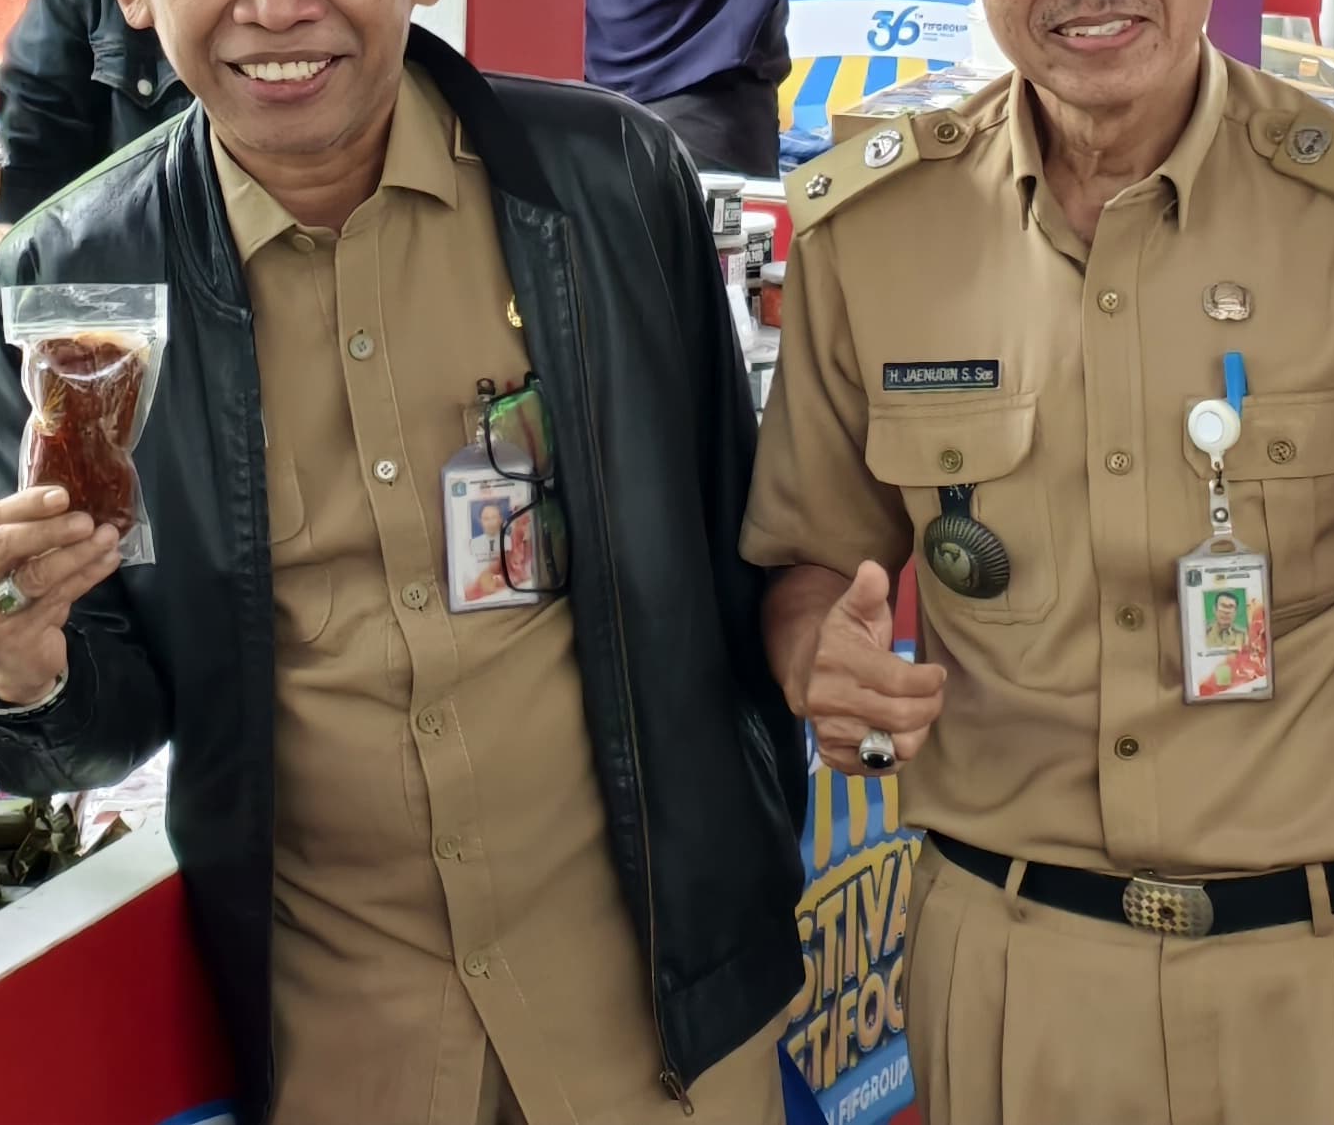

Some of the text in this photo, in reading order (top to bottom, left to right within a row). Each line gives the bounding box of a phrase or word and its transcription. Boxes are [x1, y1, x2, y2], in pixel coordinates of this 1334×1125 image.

[867, 5, 921, 52] 36
[922, 22, 969, 33] FIFGROUP
[789, 842, 914, 1022] STIVA
[837, 1055, 908, 1125] FIFGROUP
